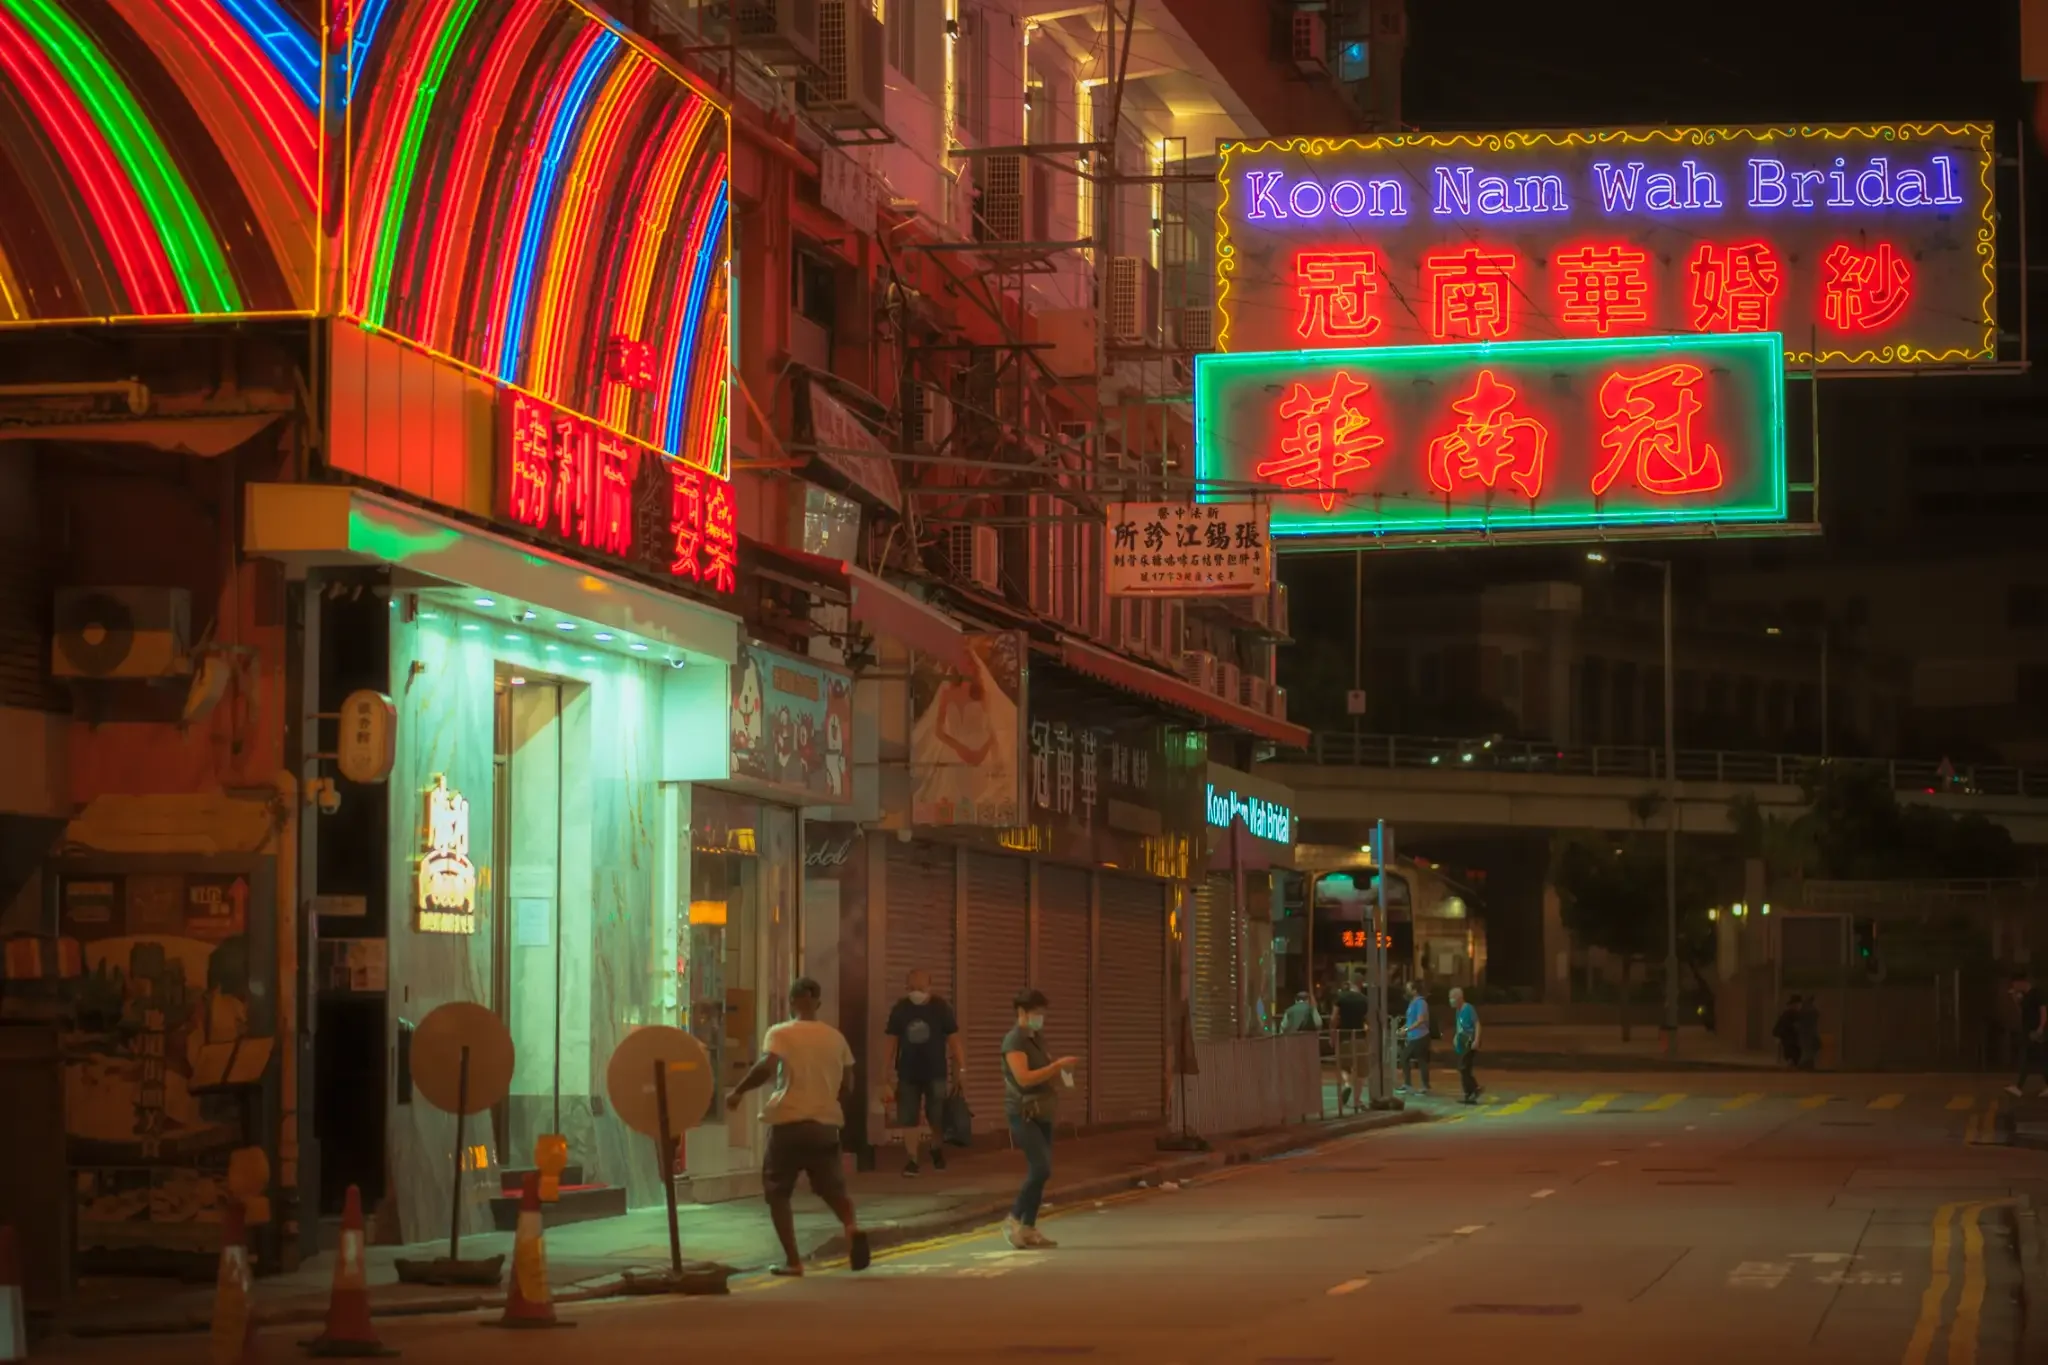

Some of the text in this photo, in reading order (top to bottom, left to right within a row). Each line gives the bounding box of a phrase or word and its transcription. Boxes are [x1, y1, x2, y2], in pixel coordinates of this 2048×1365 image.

[1246, 155, 1963, 219] Koon Nam Wah Bridal
[1296, 243, 1911, 339] 冠南華婚紗
[1206, 783, 1229, 828] Koon
[1249, 796, 1266, 838] Wah
[1267, 802, 1289, 844] Bridal
